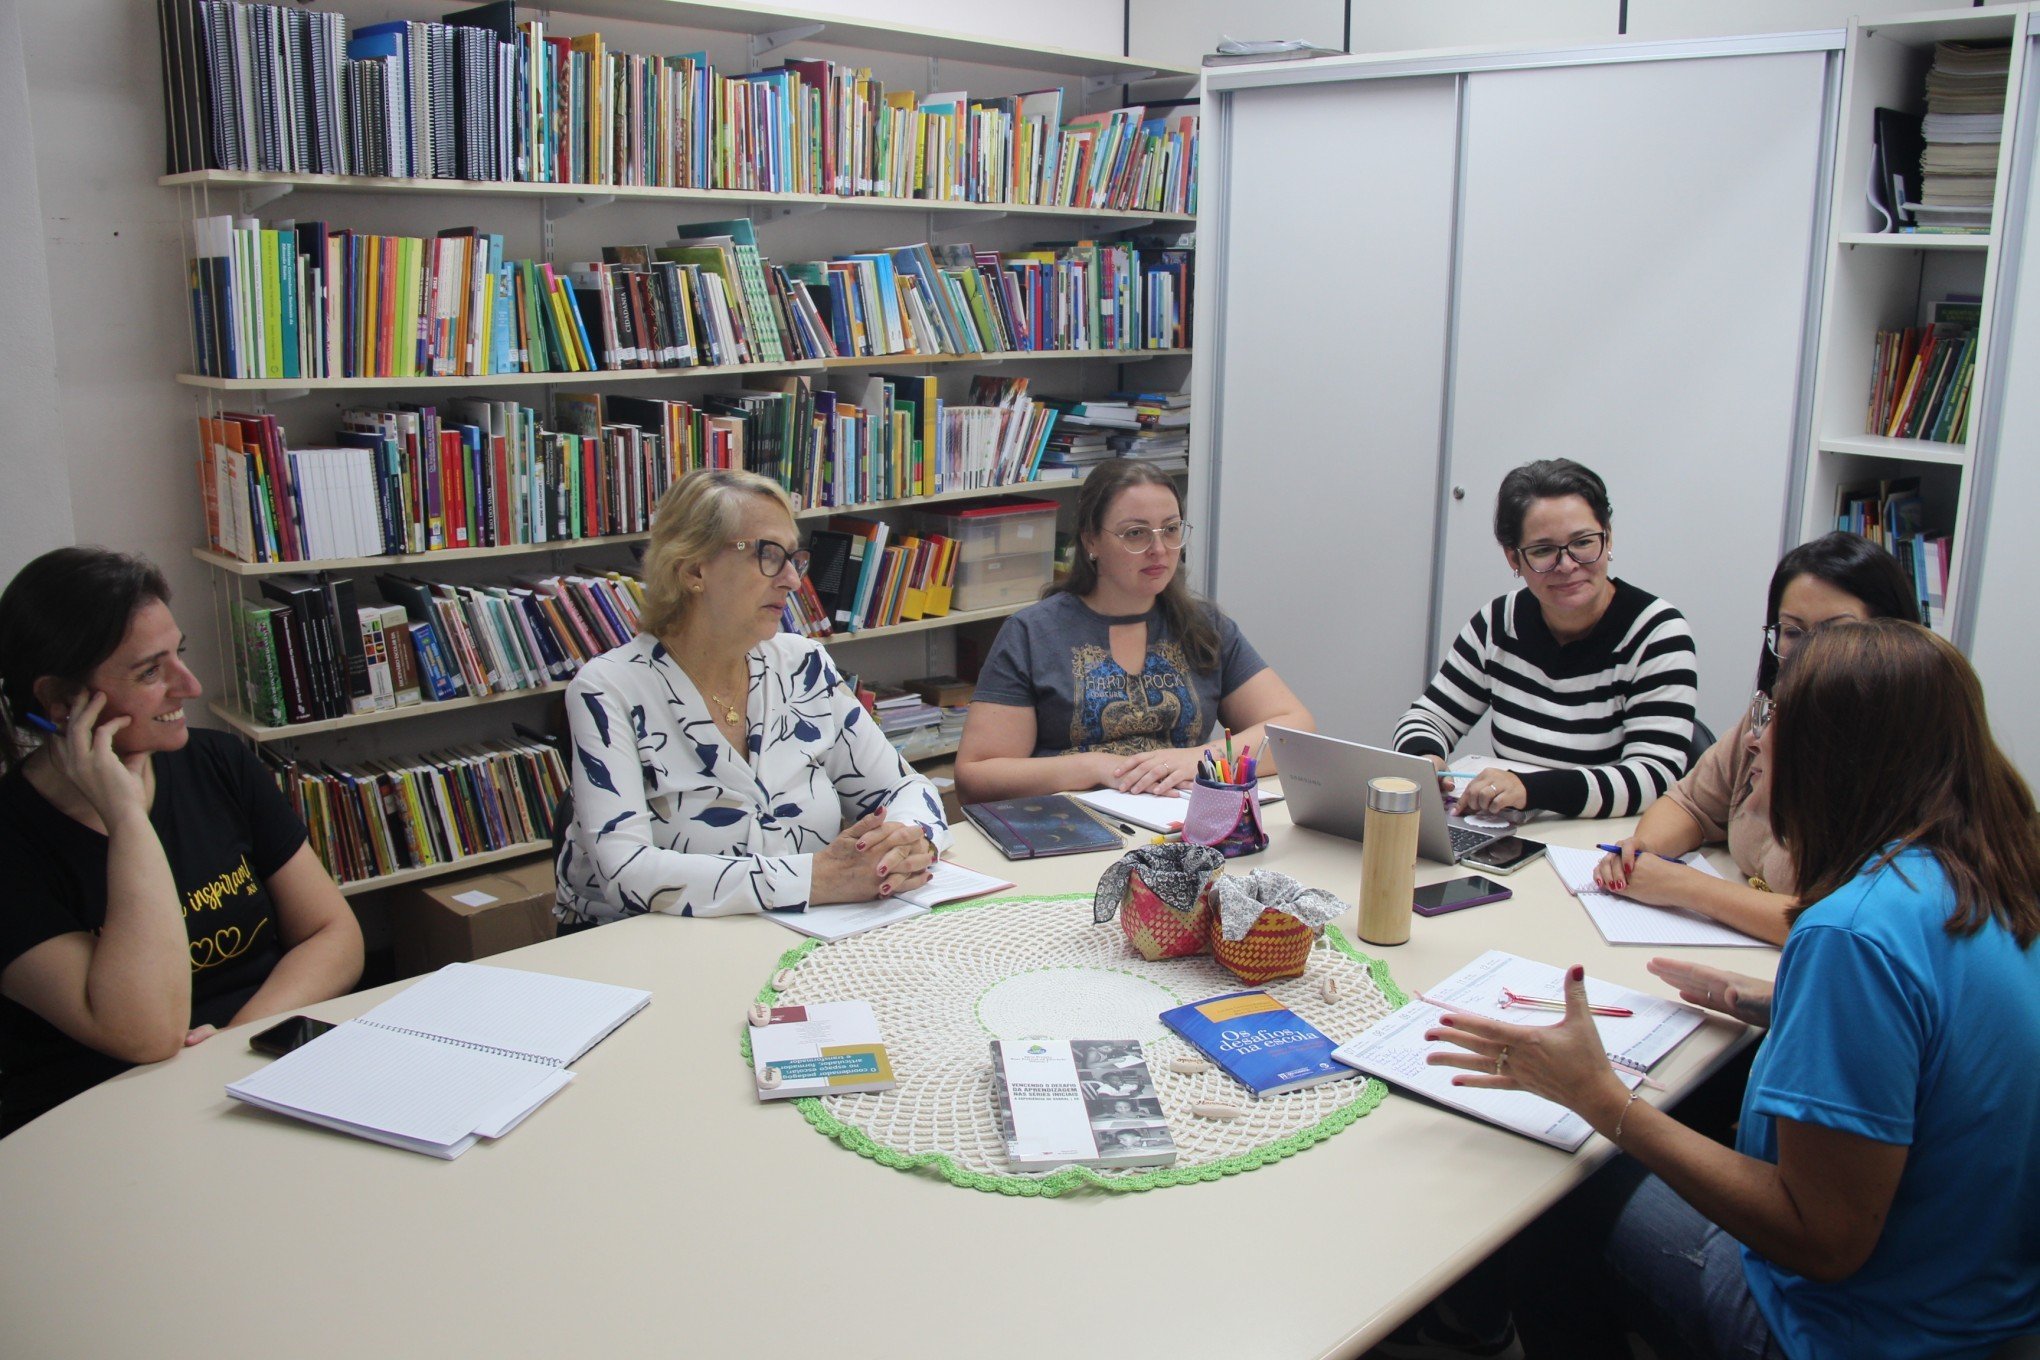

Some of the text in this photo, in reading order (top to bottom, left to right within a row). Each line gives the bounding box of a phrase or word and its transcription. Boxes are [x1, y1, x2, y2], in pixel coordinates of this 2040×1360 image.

[621, 292, 632, 332] CIDADANIA
[1085, 673, 1185, 690] HARD ROCK
[1219, 1028, 1295, 1051] desafios
[1221, 1029, 1251, 1043] Os
[1237, 1044, 1262, 1056] na
[1263, 1031, 1321, 1049] escola
[789, 1055, 845, 1064] transformador
[820, 1067, 868, 1076] coordenador
